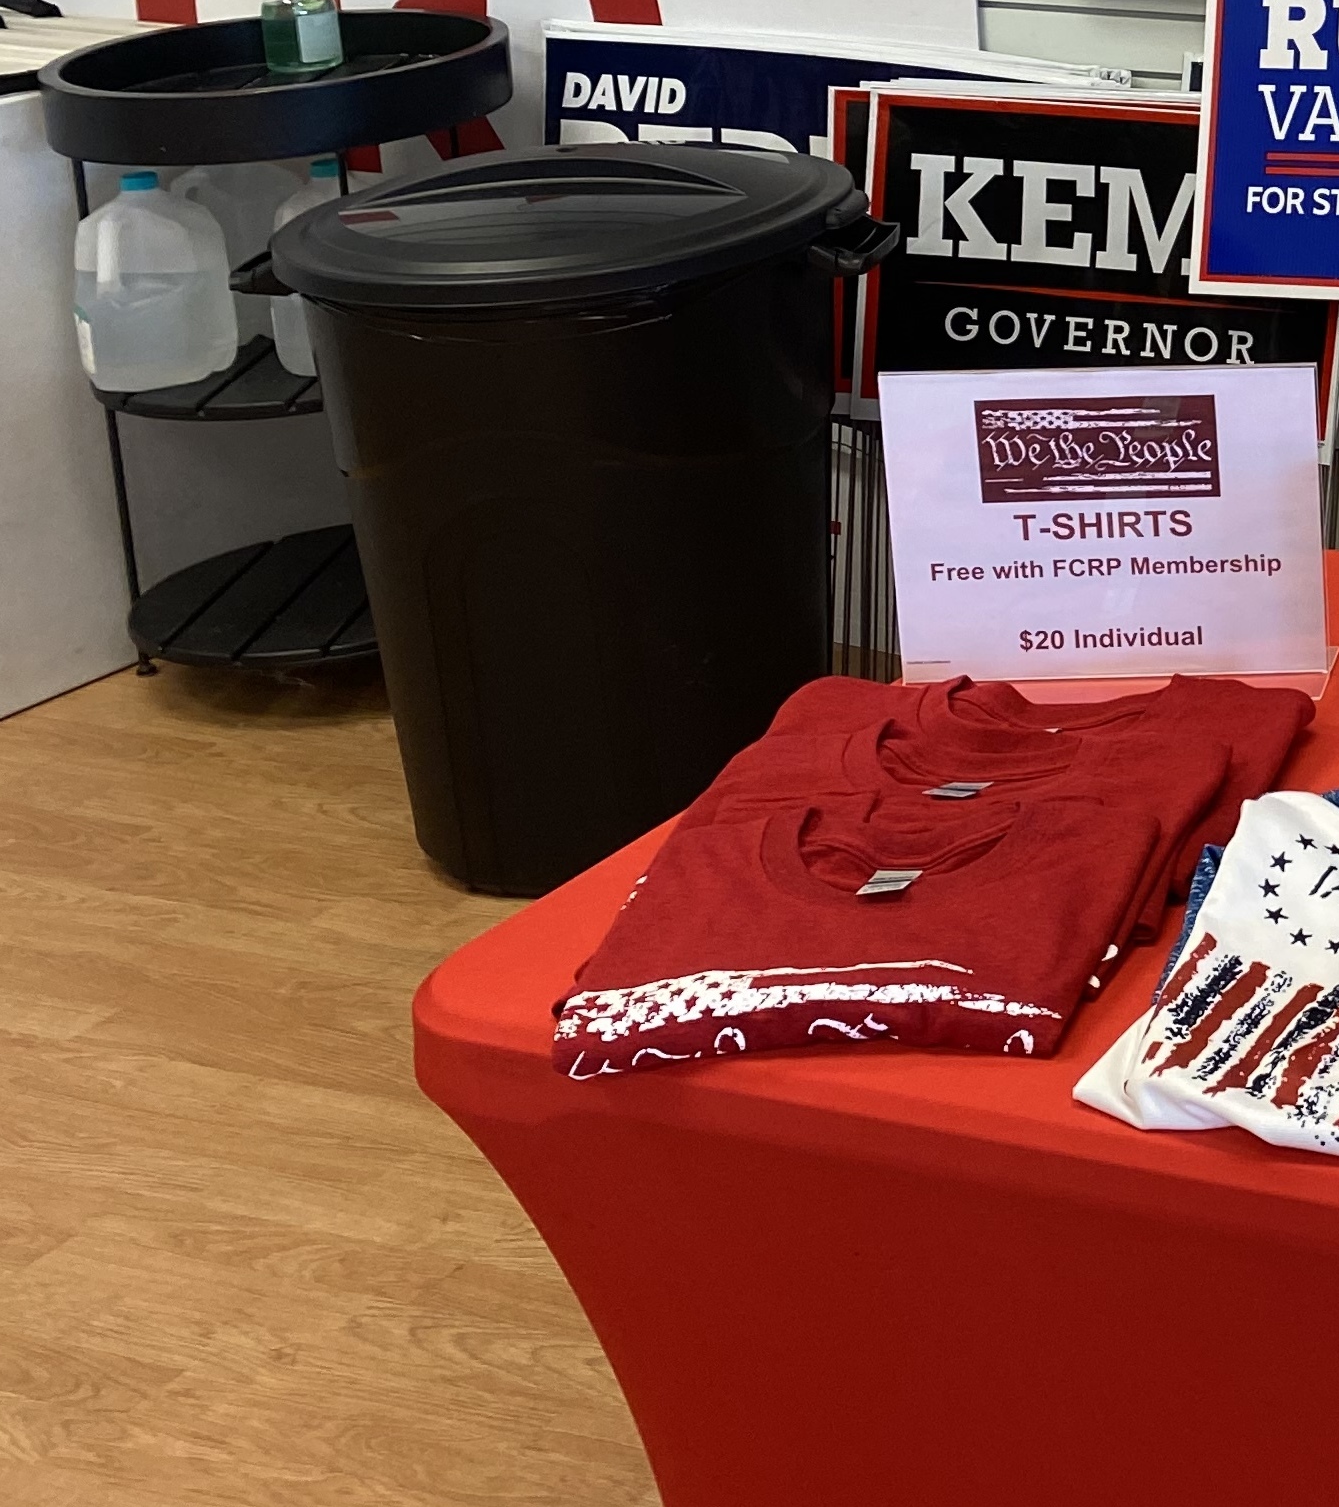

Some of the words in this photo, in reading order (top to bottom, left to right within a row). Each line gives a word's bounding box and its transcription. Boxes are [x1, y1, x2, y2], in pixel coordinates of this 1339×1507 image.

[561, 71, 687, 114] DAVID
[1246, 185, 1306, 216] FOR
[943, 305, 1256, 366] GOVERNOR
[981, 430, 1053, 471] We
[1098, 429, 1213, 472] People
[1014, 510, 1194, 541] T-SHIRTS
[930, 562, 985, 581] Free
[993, 560, 1044, 579] with
[1053, 557, 1122, 578] FCRP
[1130, 553, 1282, 577] Membership
[1019, 629, 1065, 652] $20
[1074, 625, 1203, 649] Individual
